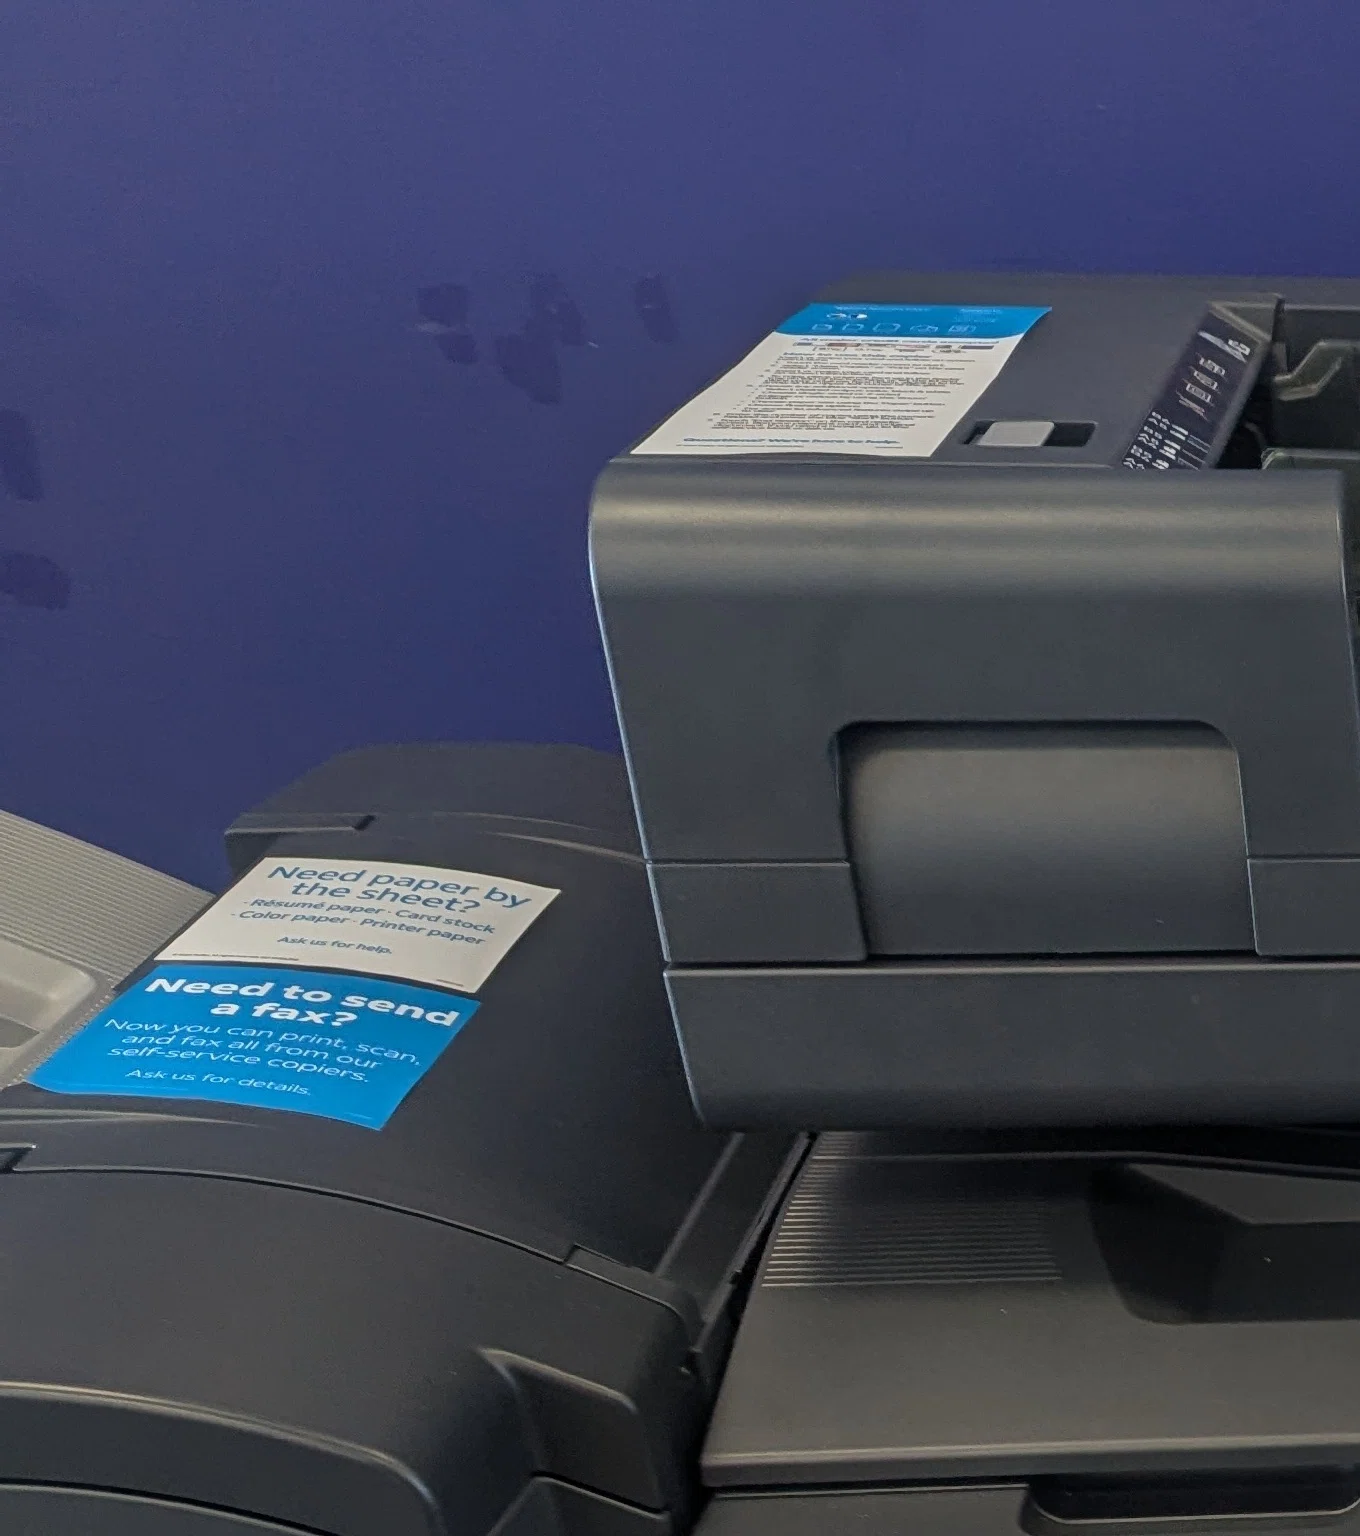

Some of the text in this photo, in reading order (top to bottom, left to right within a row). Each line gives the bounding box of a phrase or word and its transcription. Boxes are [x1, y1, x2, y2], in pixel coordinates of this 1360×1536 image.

[267, 865, 533, 909] Need paper by
[291, 881, 481, 914] the sheet?
[238, 910, 486, 946] Color paper Printer paper
[327, 903, 385, 915] paper
[395, 909, 440, 923] Card
[442, 917, 497, 935] stock
[144, 978, 461, 1027] Need to send
[210, 1002, 359, 1028] a fax?
[104, 1018, 423, 1066] Now you can print, scan,
[121, 1034, 383, 1071] and fax all from our
